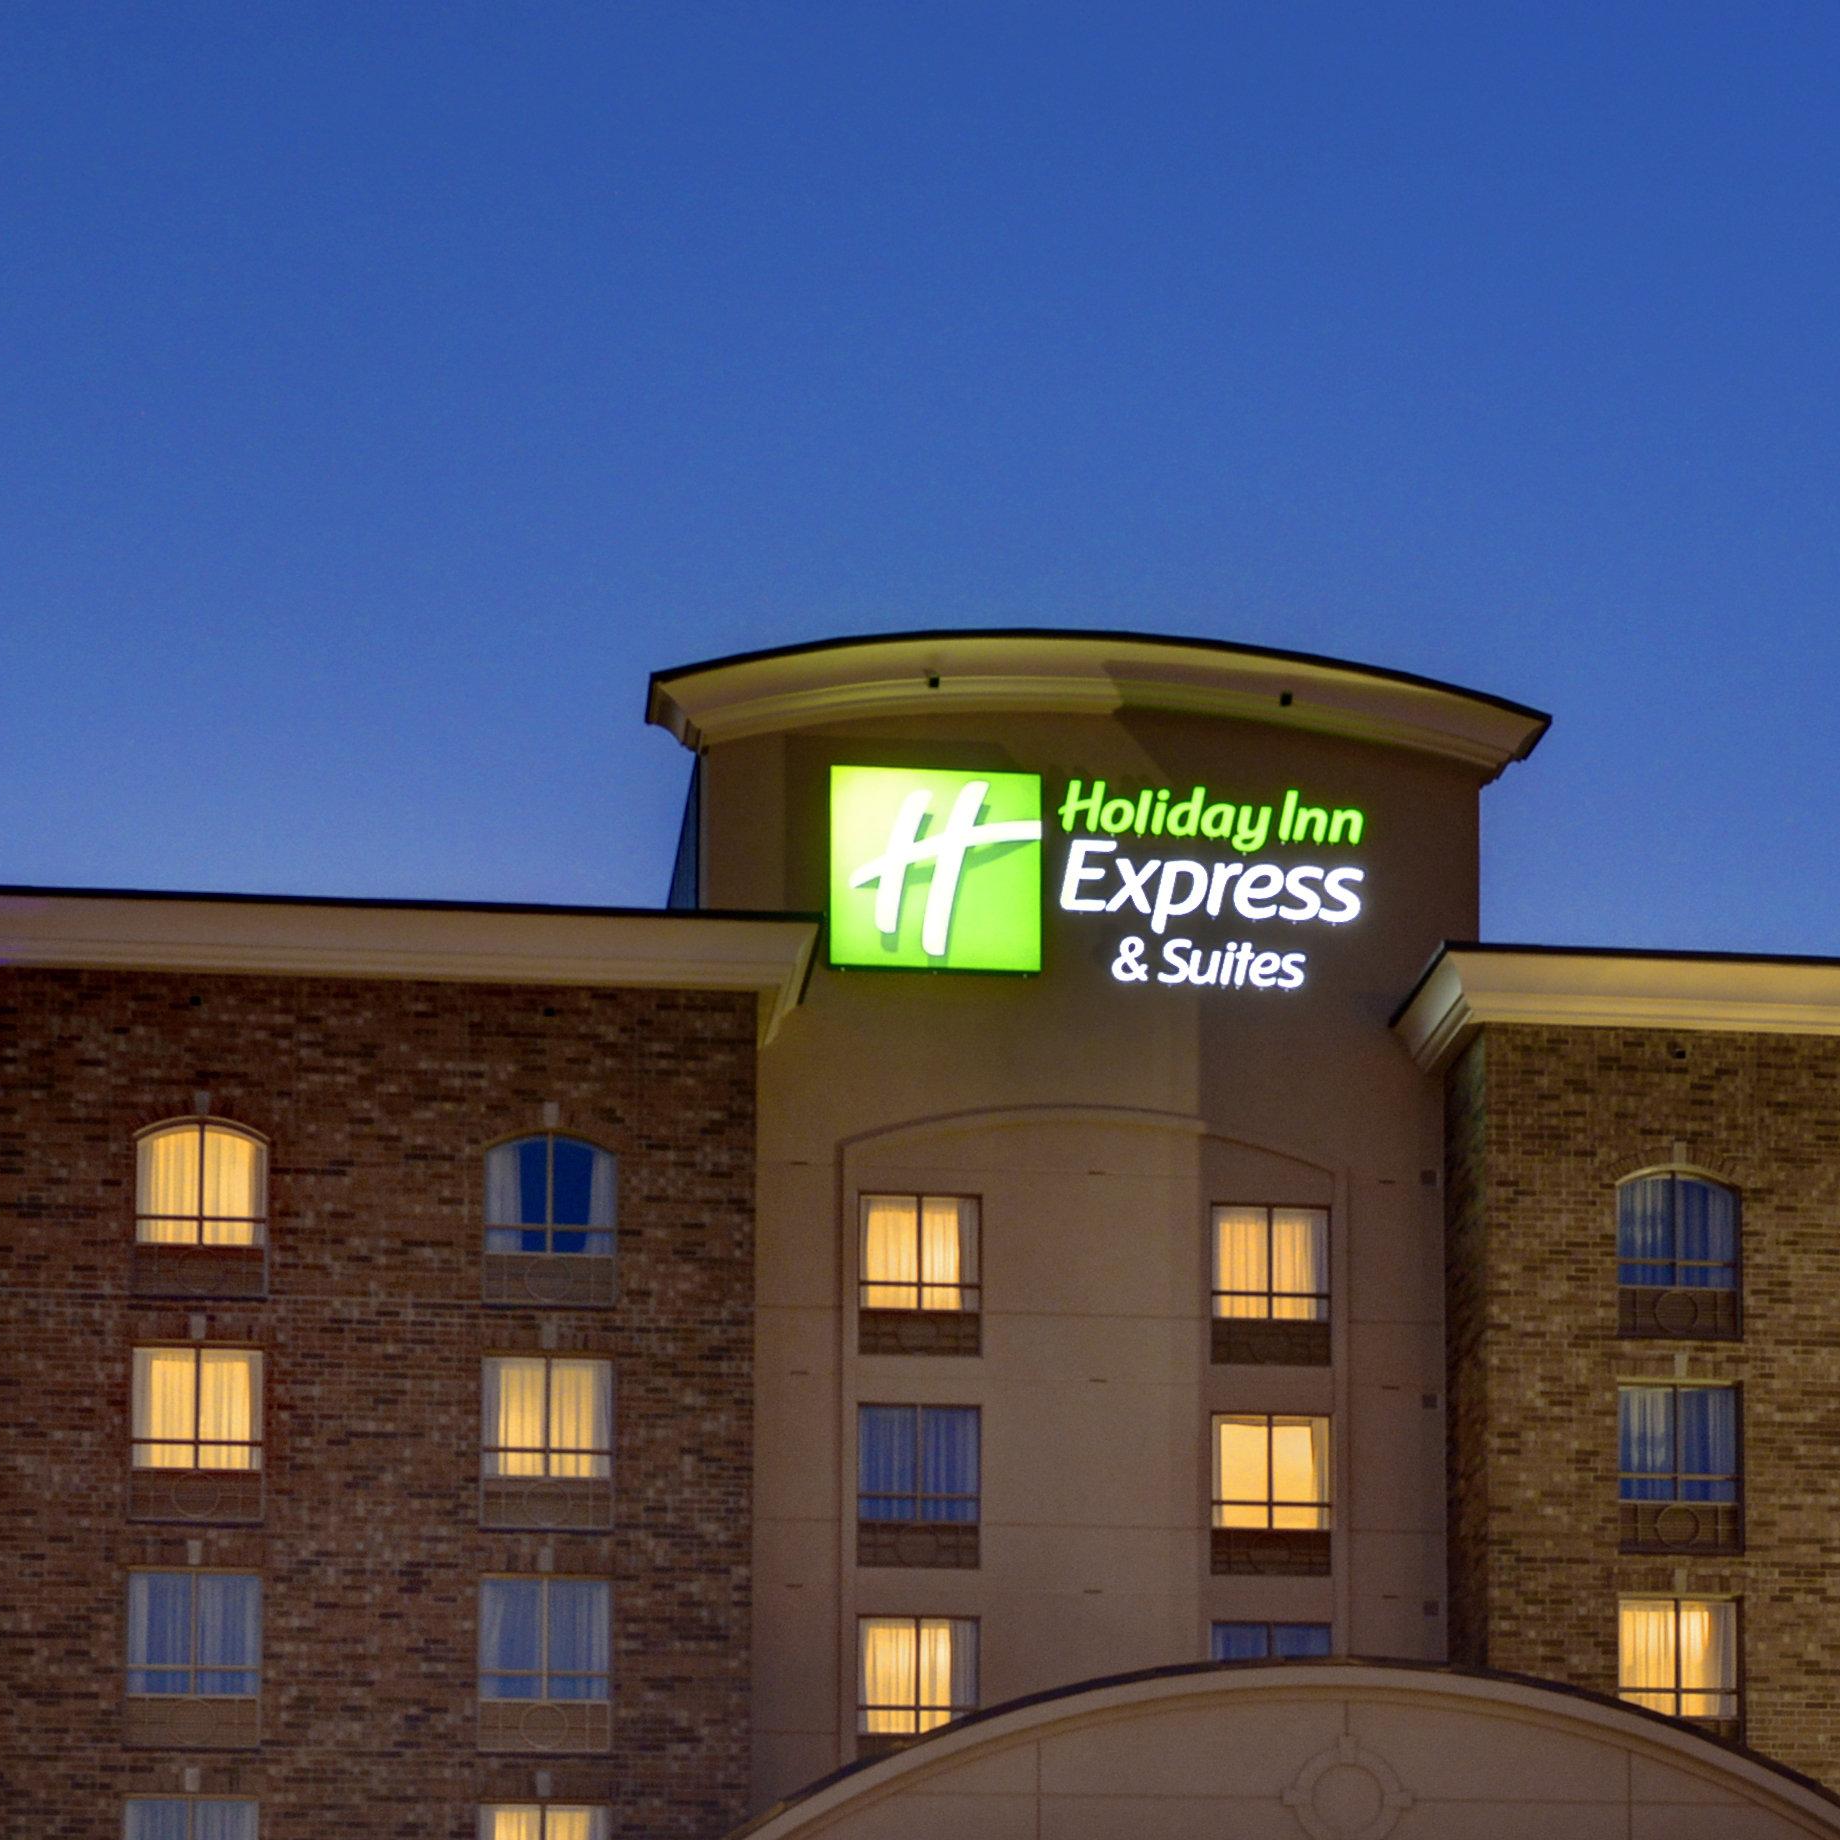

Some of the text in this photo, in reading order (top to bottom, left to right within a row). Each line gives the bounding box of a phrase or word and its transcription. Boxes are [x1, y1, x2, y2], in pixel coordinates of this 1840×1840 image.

[1058, 780, 1364, 853] Holiday Inn
[1060, 839, 1365, 934] Express
[1111, 936, 1307, 989] & Suites
